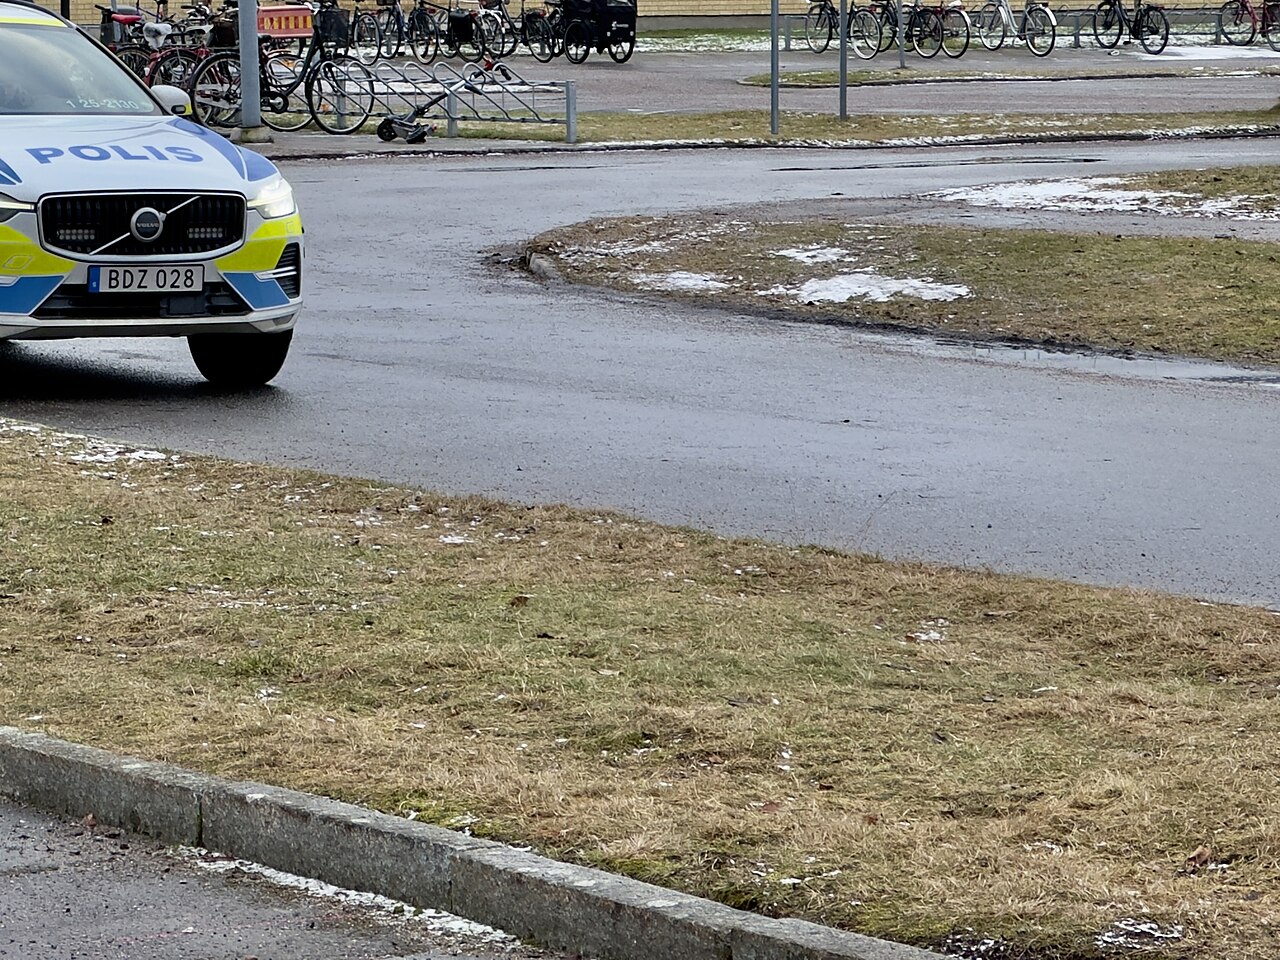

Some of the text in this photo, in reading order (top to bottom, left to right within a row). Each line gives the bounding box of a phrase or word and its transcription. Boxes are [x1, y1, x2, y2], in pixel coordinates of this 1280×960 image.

[79, 97, 140, 110] 25-2130
[25, 145, 204, 165] POLIS
[108, 269, 194, 289] BDZ 028
